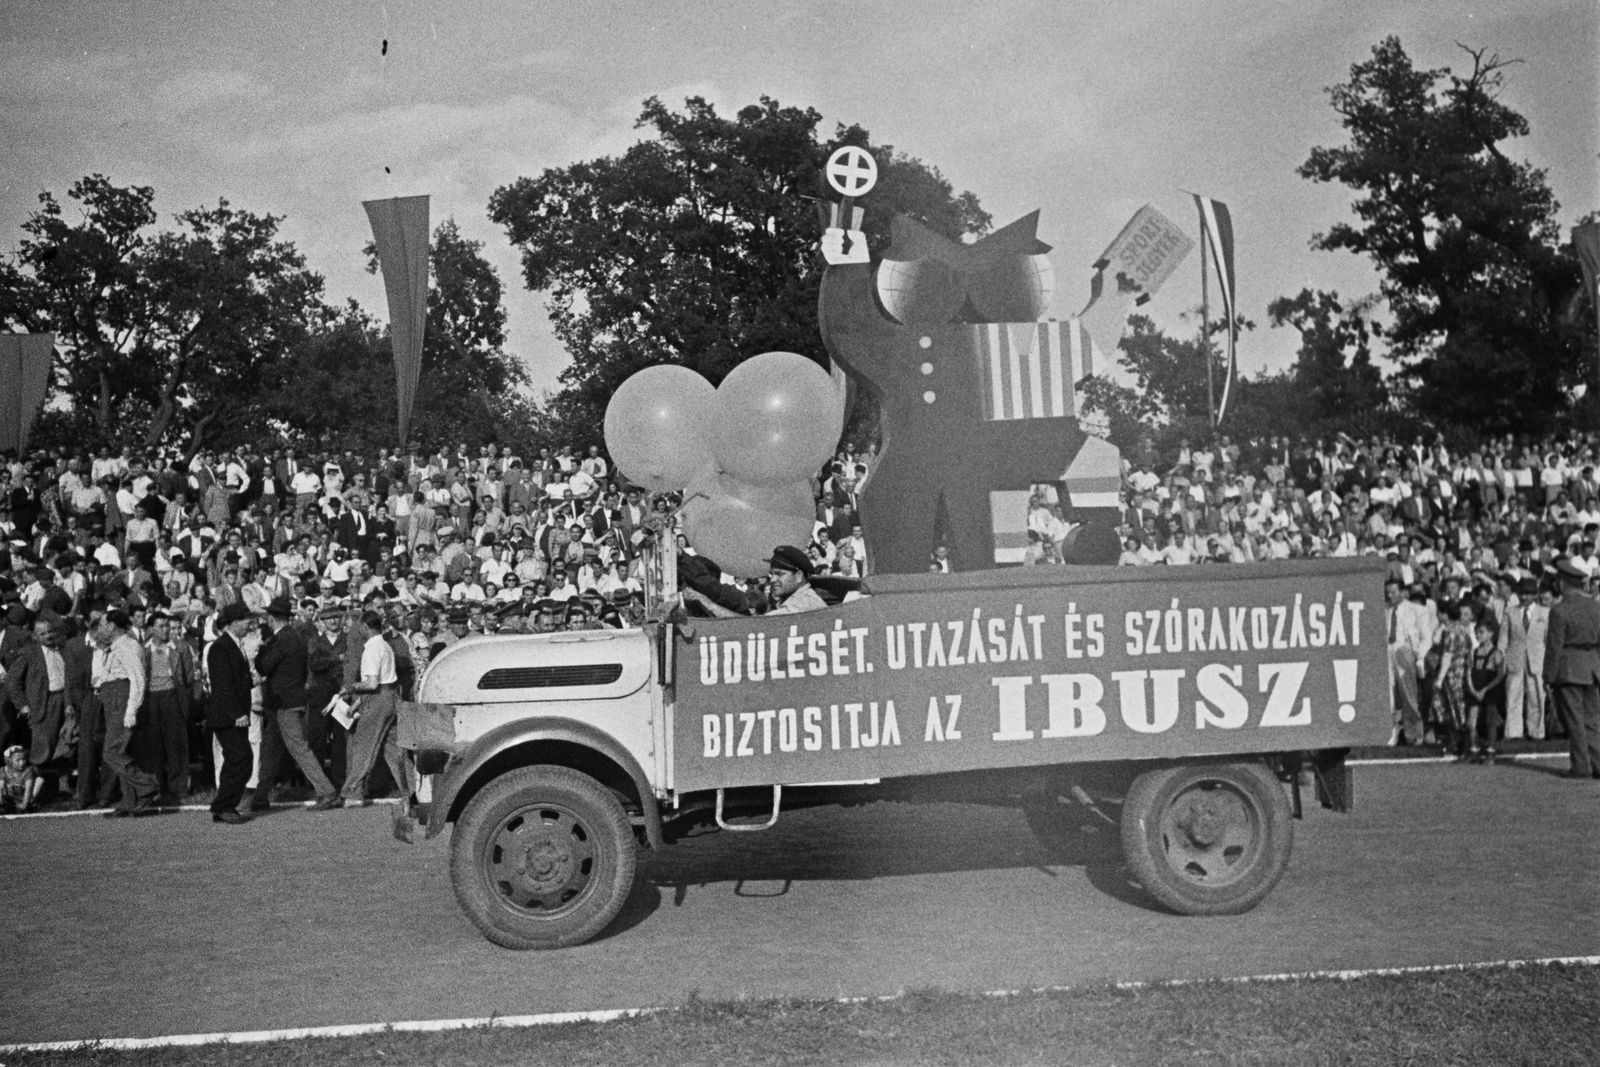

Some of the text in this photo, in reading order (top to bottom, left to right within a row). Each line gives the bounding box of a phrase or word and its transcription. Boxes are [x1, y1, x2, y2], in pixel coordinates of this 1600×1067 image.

[886, 604, 1045, 669] UTAZÁSÁT
[1065, 602, 1105, 658] ÉS
[1125, 591, 1364, 656] SZÓRAKOZÁSÁT
[703, 700, 901, 757] BIZTOSITJA
[924, 694, 962, 742] AZ
